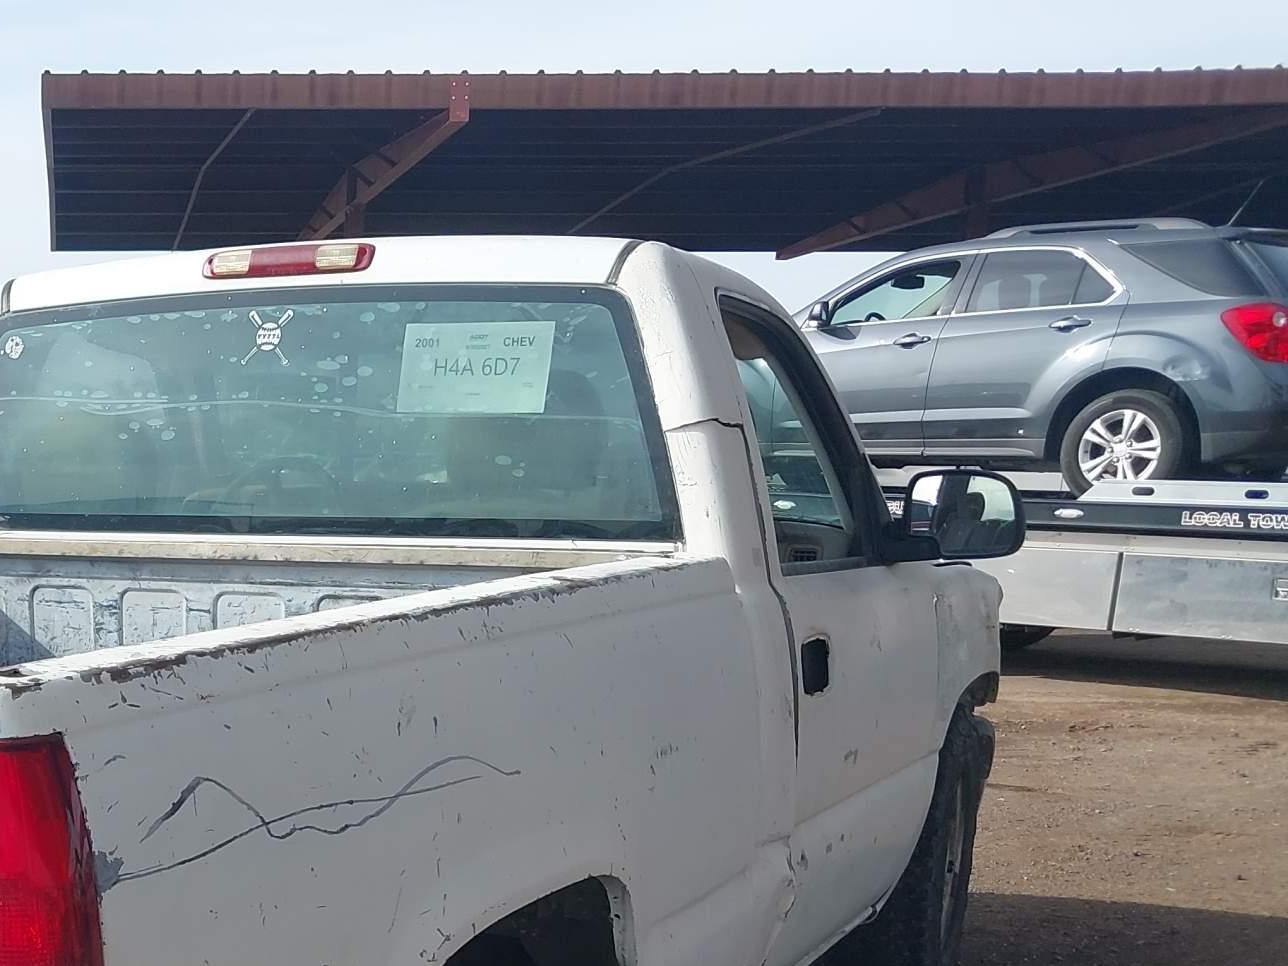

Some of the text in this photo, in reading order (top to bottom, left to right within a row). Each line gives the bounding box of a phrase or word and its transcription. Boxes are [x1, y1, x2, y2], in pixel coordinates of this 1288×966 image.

[415, 338, 440, 348] 2001
[503, 336, 536, 347] CHEV
[433, 357, 521, 377] H4A 6D7
[1181, 510, 1244, 528] LOCAL
